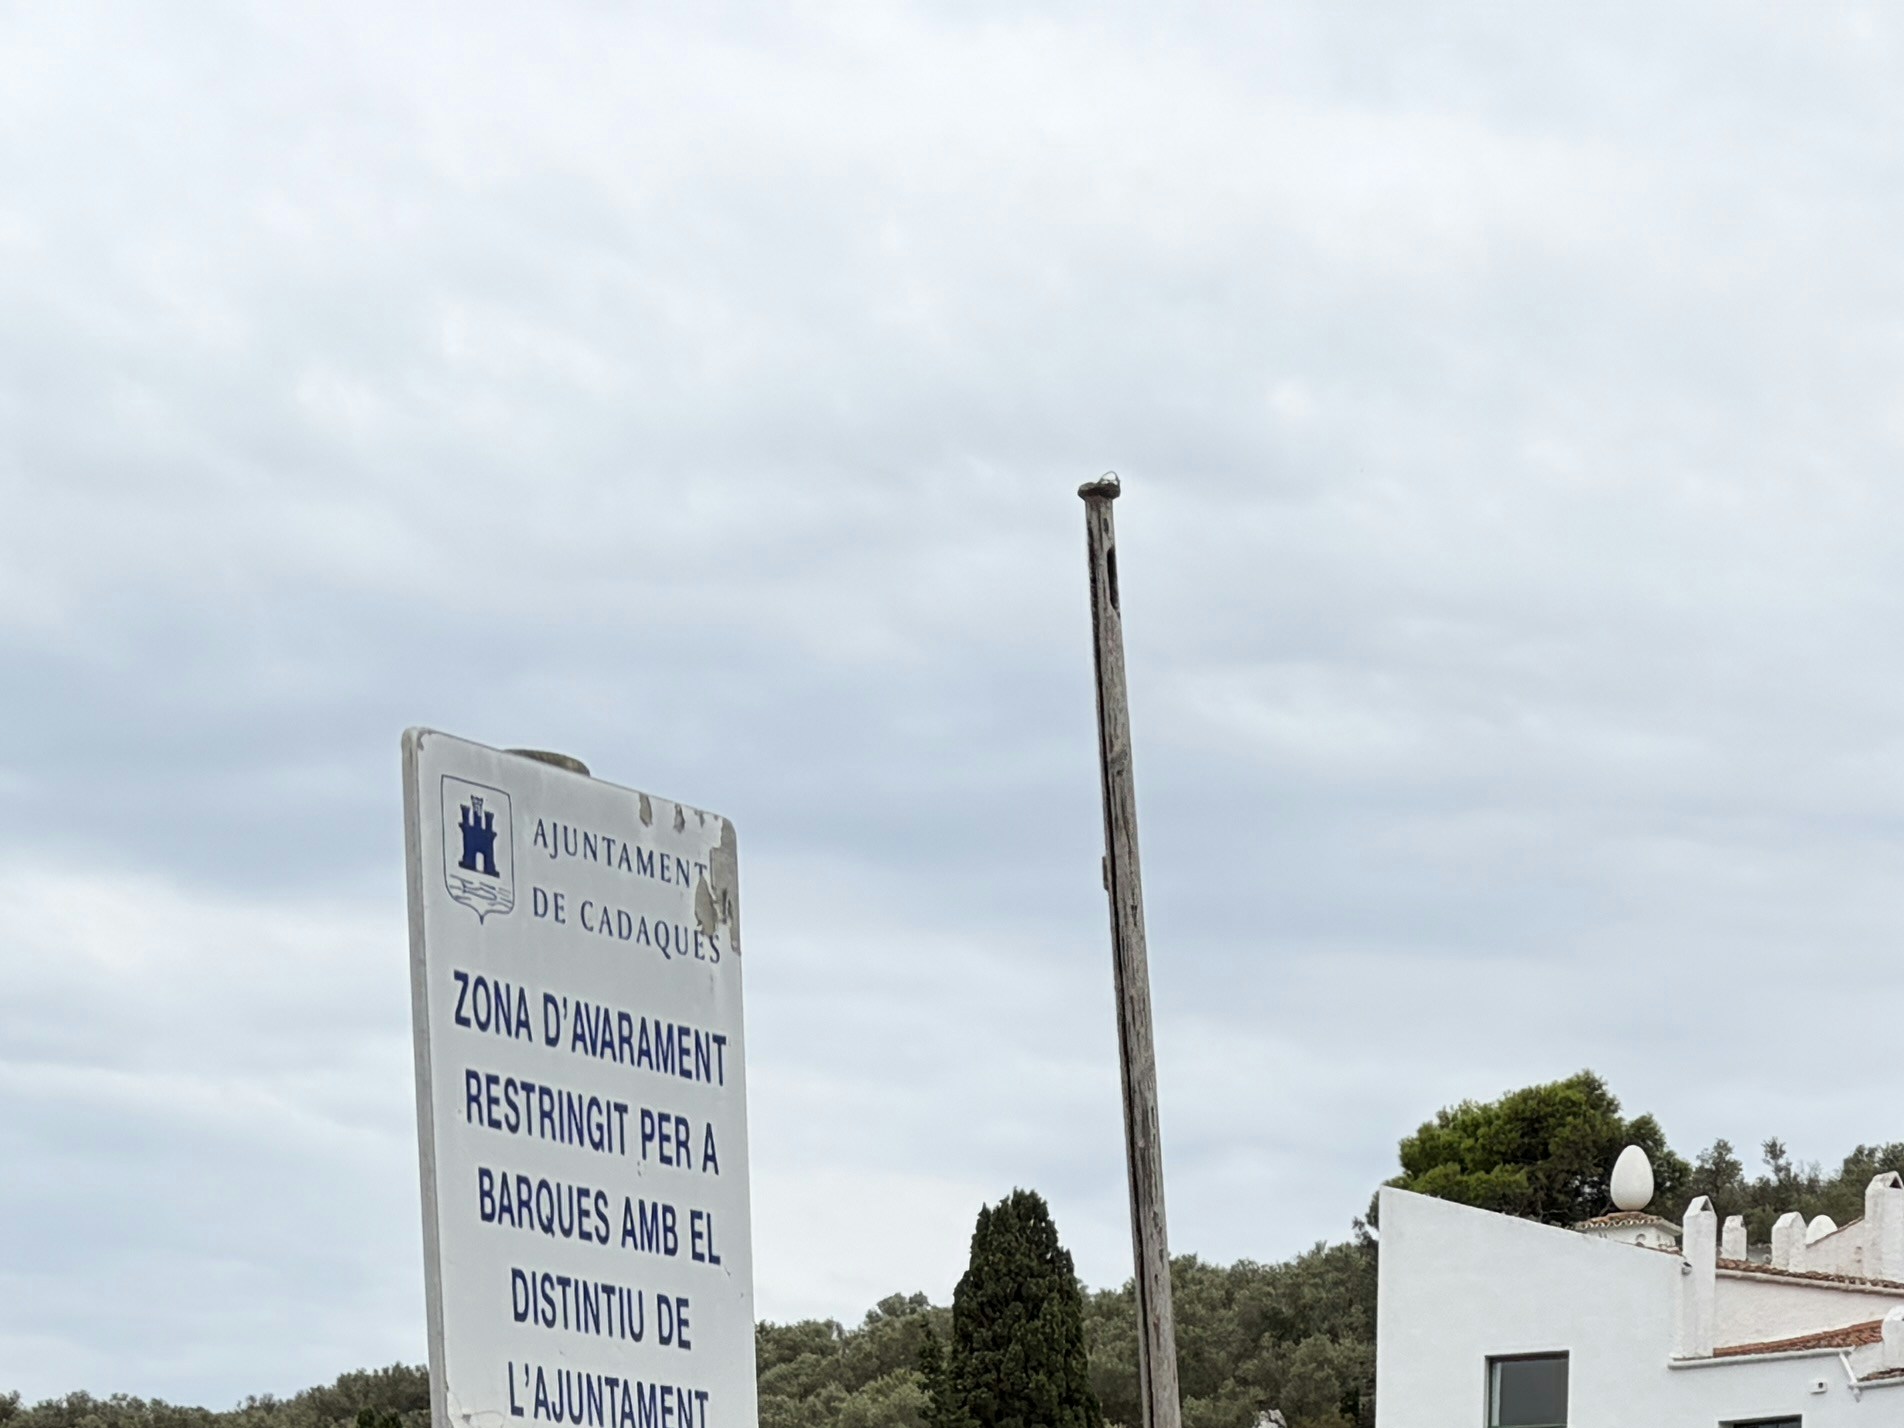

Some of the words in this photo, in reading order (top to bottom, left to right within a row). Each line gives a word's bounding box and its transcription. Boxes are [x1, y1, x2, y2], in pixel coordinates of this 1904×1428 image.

[533, 887, 566, 924] DE
[454, 969, 533, 1042] ZONA
[543, 992, 727, 1086] D'AVARAMENT
[465, 1068, 628, 1156] RESTRINGIT
[640, 1107, 692, 1170] PER
[702, 1122, 720, 1176] A
[478, 1166, 610, 1245] BARQUES
[621, 1196, 678, 1257] AMB
[690, 1209, 721, 1265] EL
[511, 1267, 644, 1343] DISTINTIU
[657, 1293, 691, 1350] DE
